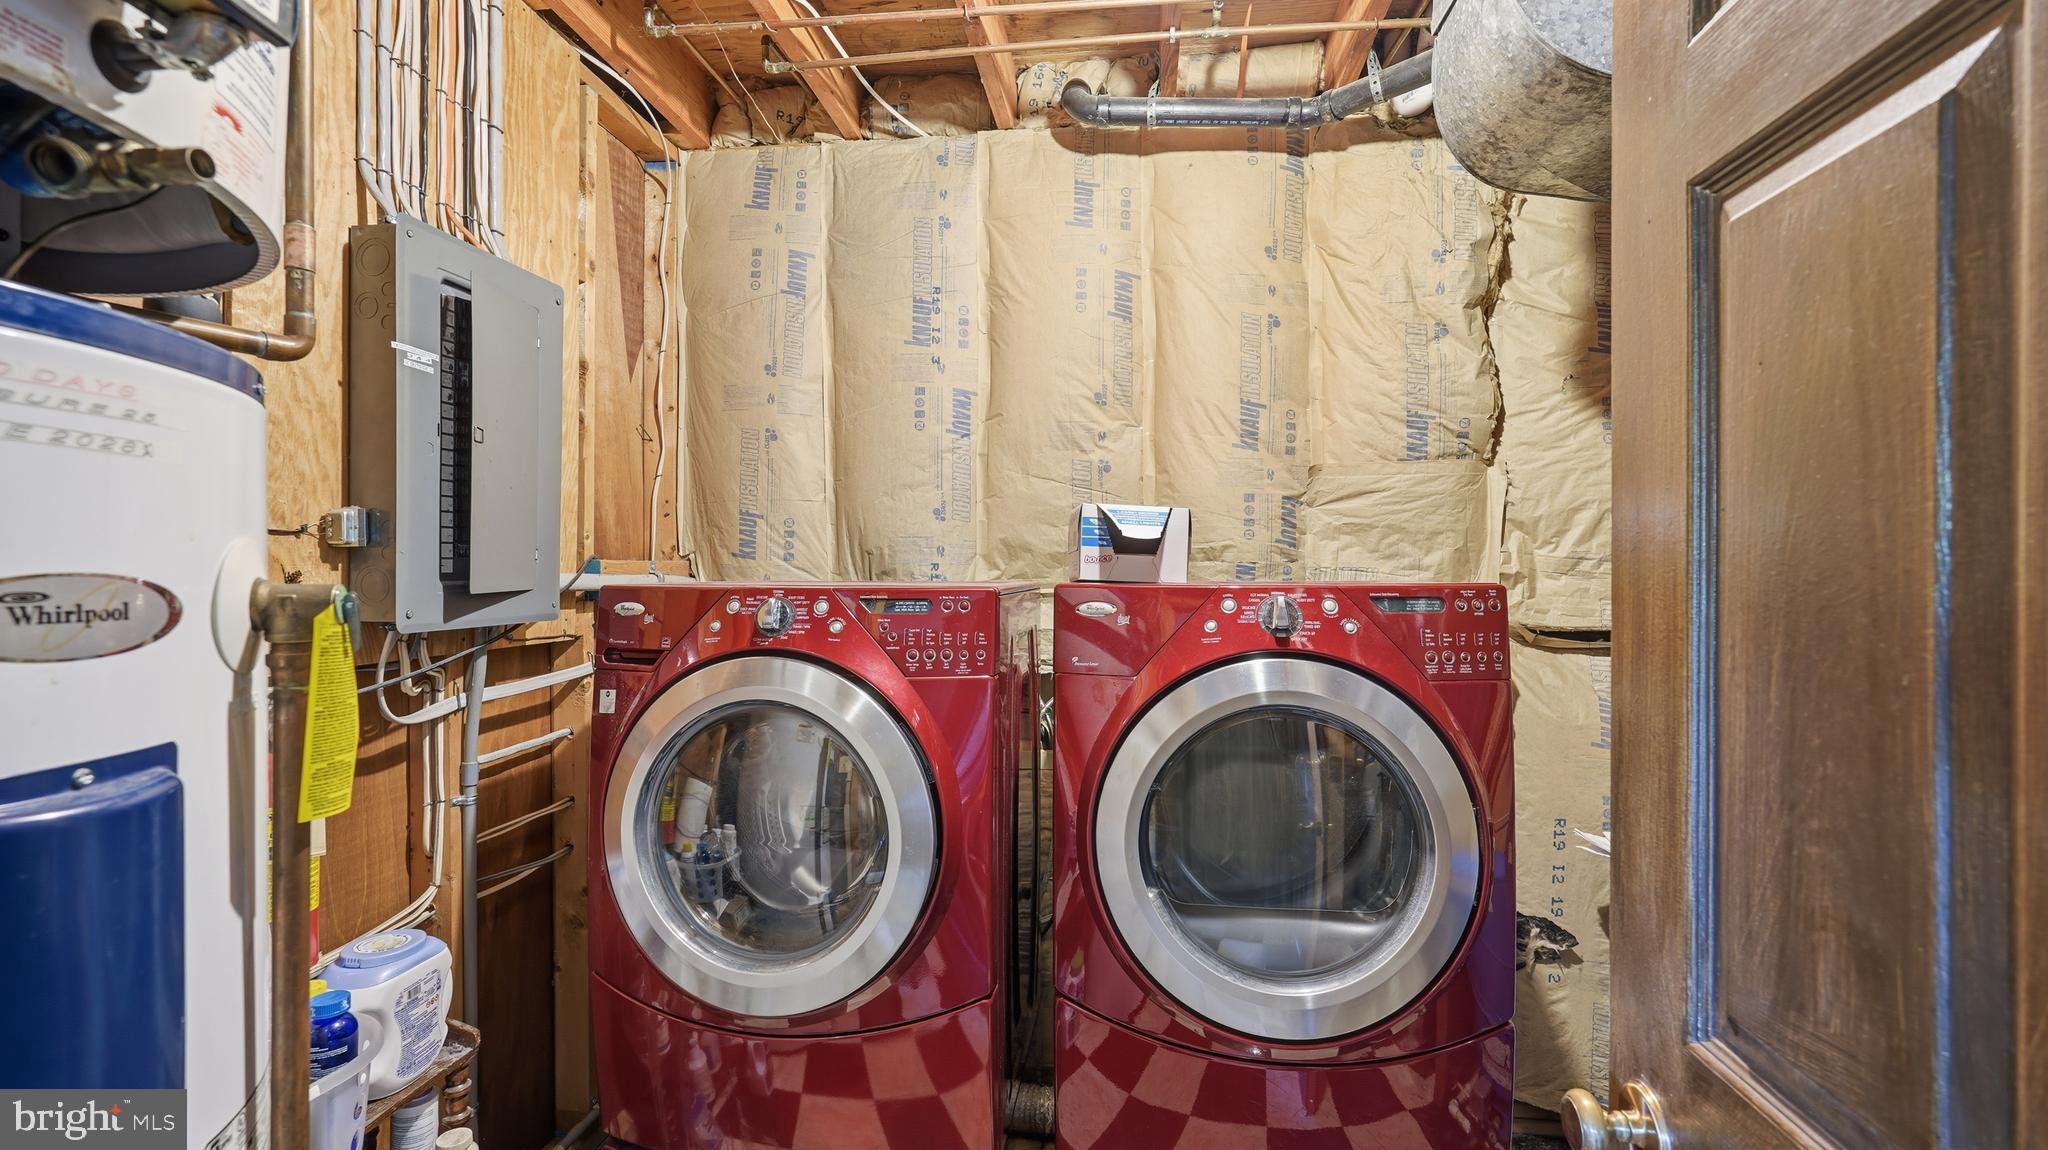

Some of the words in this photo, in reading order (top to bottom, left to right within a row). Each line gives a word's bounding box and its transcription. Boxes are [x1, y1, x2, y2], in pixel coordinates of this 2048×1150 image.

[744, 168, 779, 212] KNAUF
[1064, 178, 1101, 230] KNAUF
[1283, 174, 1306, 264] INSULATION
[780, 249, 817, 298] KNAUF
[913, 217, 934, 299] INSULATION
[903, 297, 934, 348] KNAUF
[932, 286, 941, 316] R19
[1107, 269, 1142, 324] KNAUF
[783, 295, 806, 379] INSULATION
[1239, 312, 1263, 401] INSULATION
[1112, 321, 1134, 408] INSULATION
[1405, 322, 1429, 412] INSULATION
[946, 388, 978, 438] KNAUF
[1231, 398, 1267, 453] KNAUF
[739, 427, 760, 512] INSULATION
[951, 435, 973, 524] INSULATION
[731, 509, 764, 561] KNAUF
[6, 601, 130, 629] Whirlpool
[1553, 817, 1567, 852] R19
[1550, 896, 1566, 919] 19
